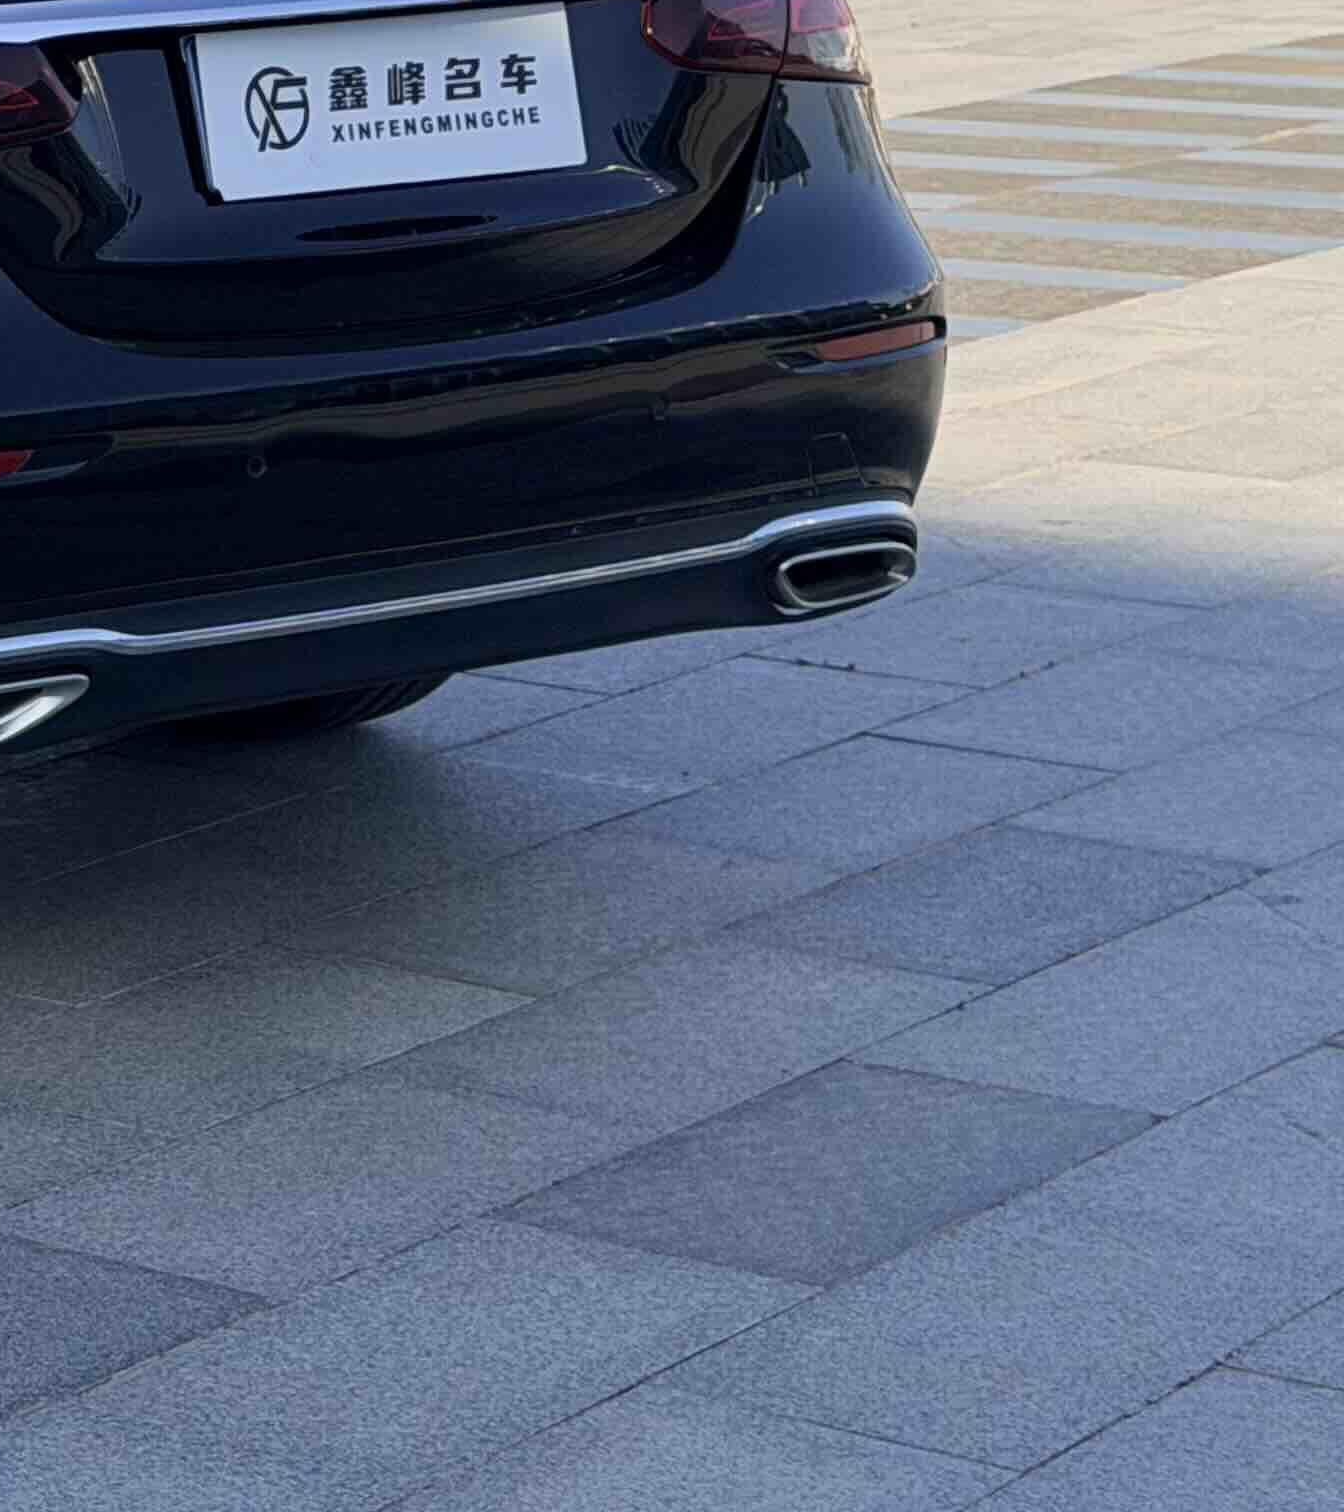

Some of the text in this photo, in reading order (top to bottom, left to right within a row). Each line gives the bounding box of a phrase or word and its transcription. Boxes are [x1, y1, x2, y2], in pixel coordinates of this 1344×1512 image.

[328, 53, 537, 113] 鑫峰名车
[331, 105, 542, 143] XINFENGMINGCHE
